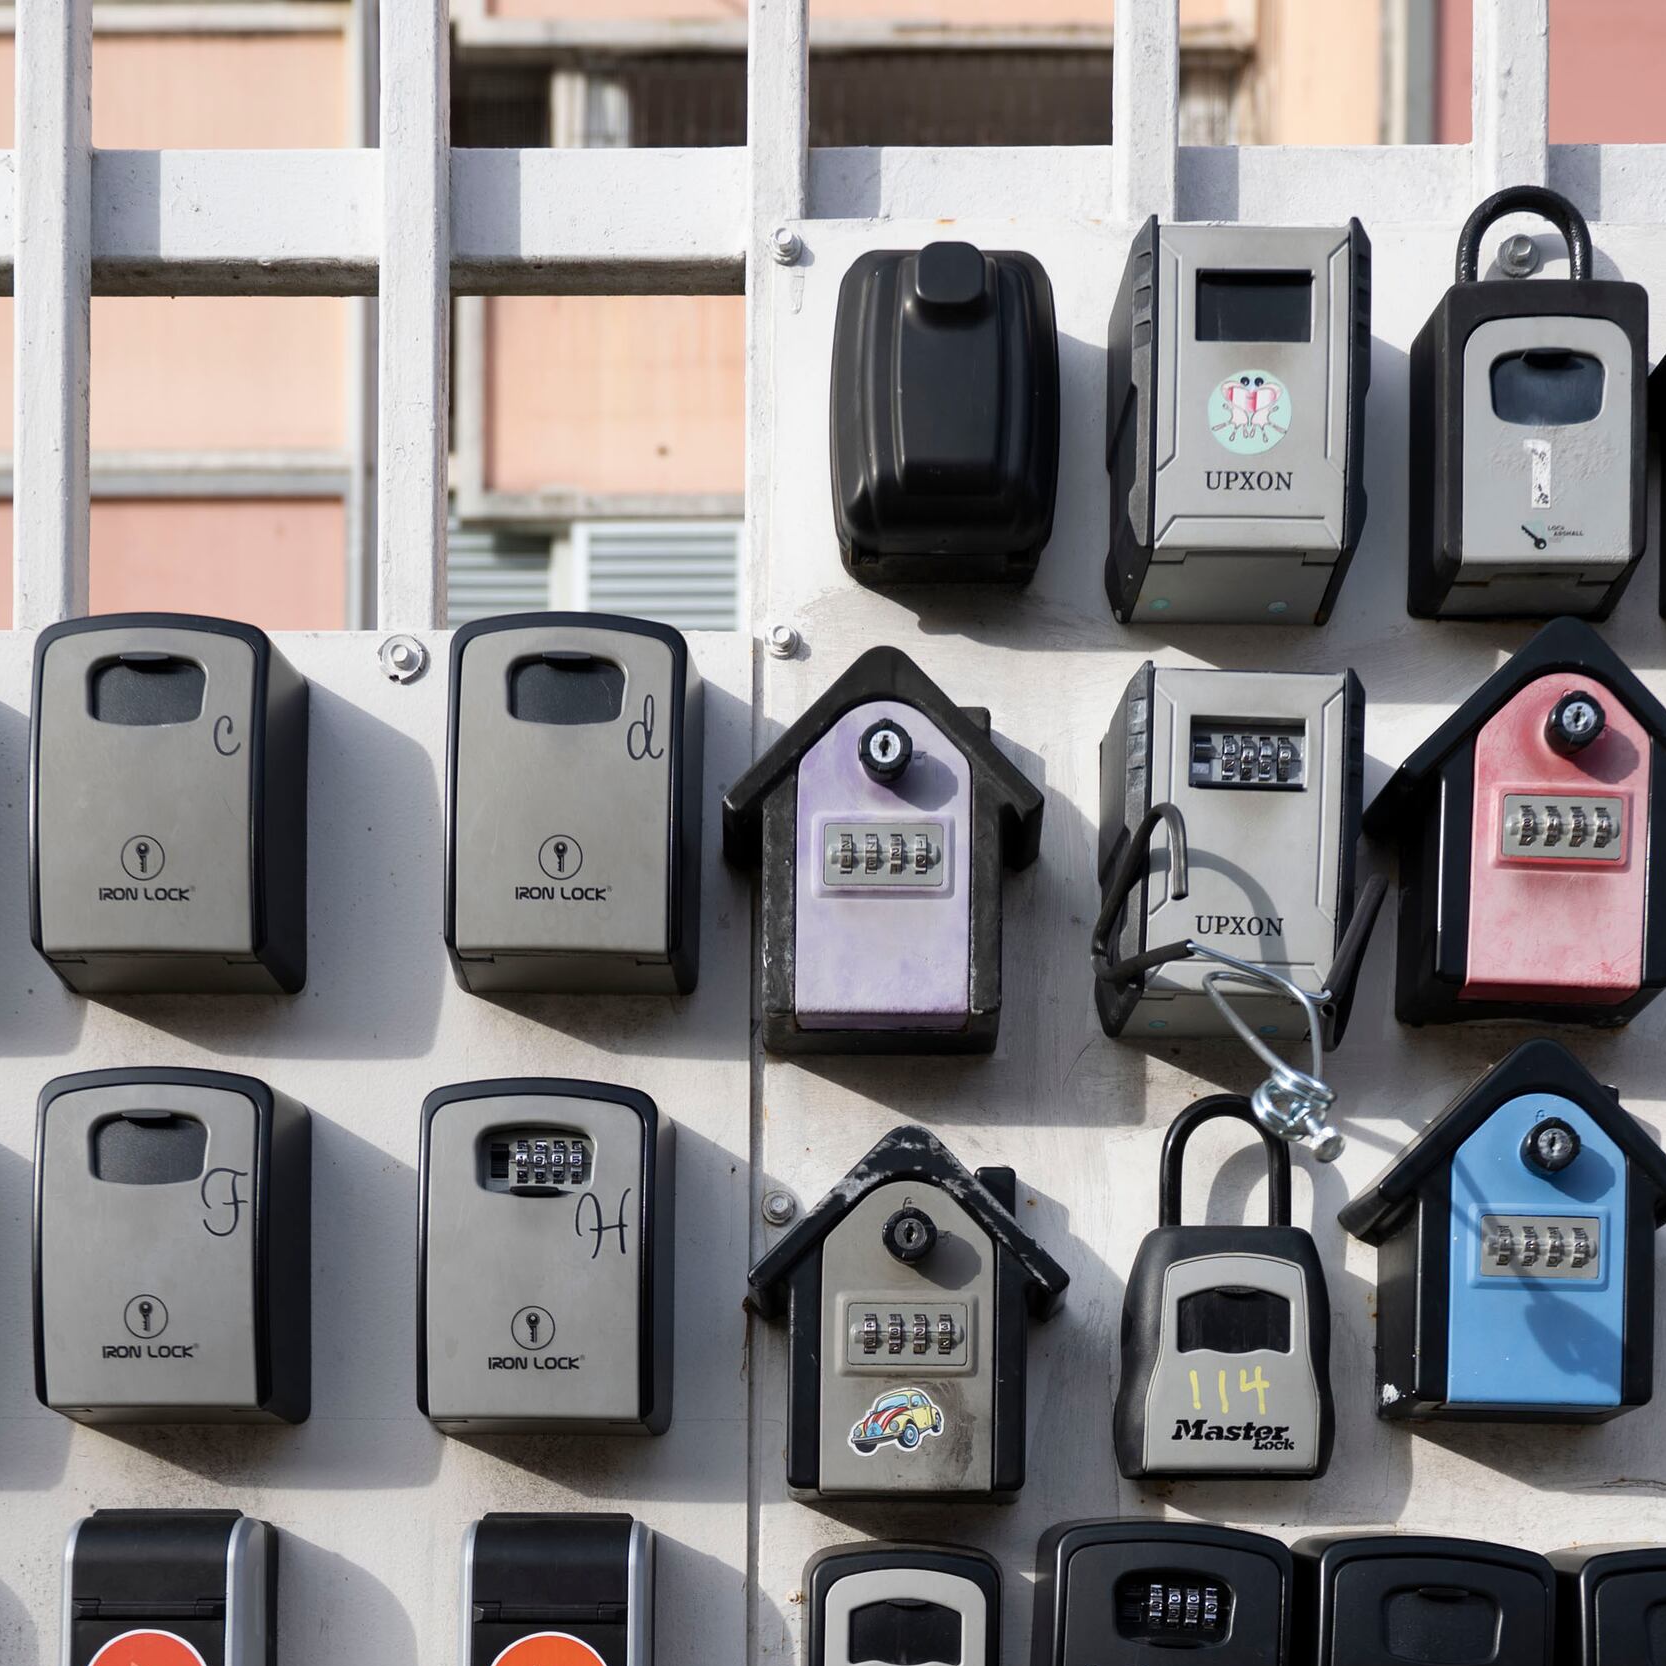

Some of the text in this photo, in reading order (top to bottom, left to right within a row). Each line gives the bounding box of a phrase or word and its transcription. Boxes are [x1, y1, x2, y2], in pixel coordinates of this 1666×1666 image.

[1204, 470, 1294, 492] UPXON
[626, 694, 665, 761] d
[99, 888, 190, 902] IRON LOCK
[515, 887, 606, 901] IRON LOCK
[1194, 914, 1286, 938] UPXON
[575, 1187, 632, 1260] H
[102, 1346, 193, 1359] IRON LOCK
[488, 1357, 580, 1370] IRON LOCK
[1188, 1365, 1271, 1415] 114
[1171, 1418, 1290, 1444] Master
[1252, 1437, 1295, 1451] Lock
